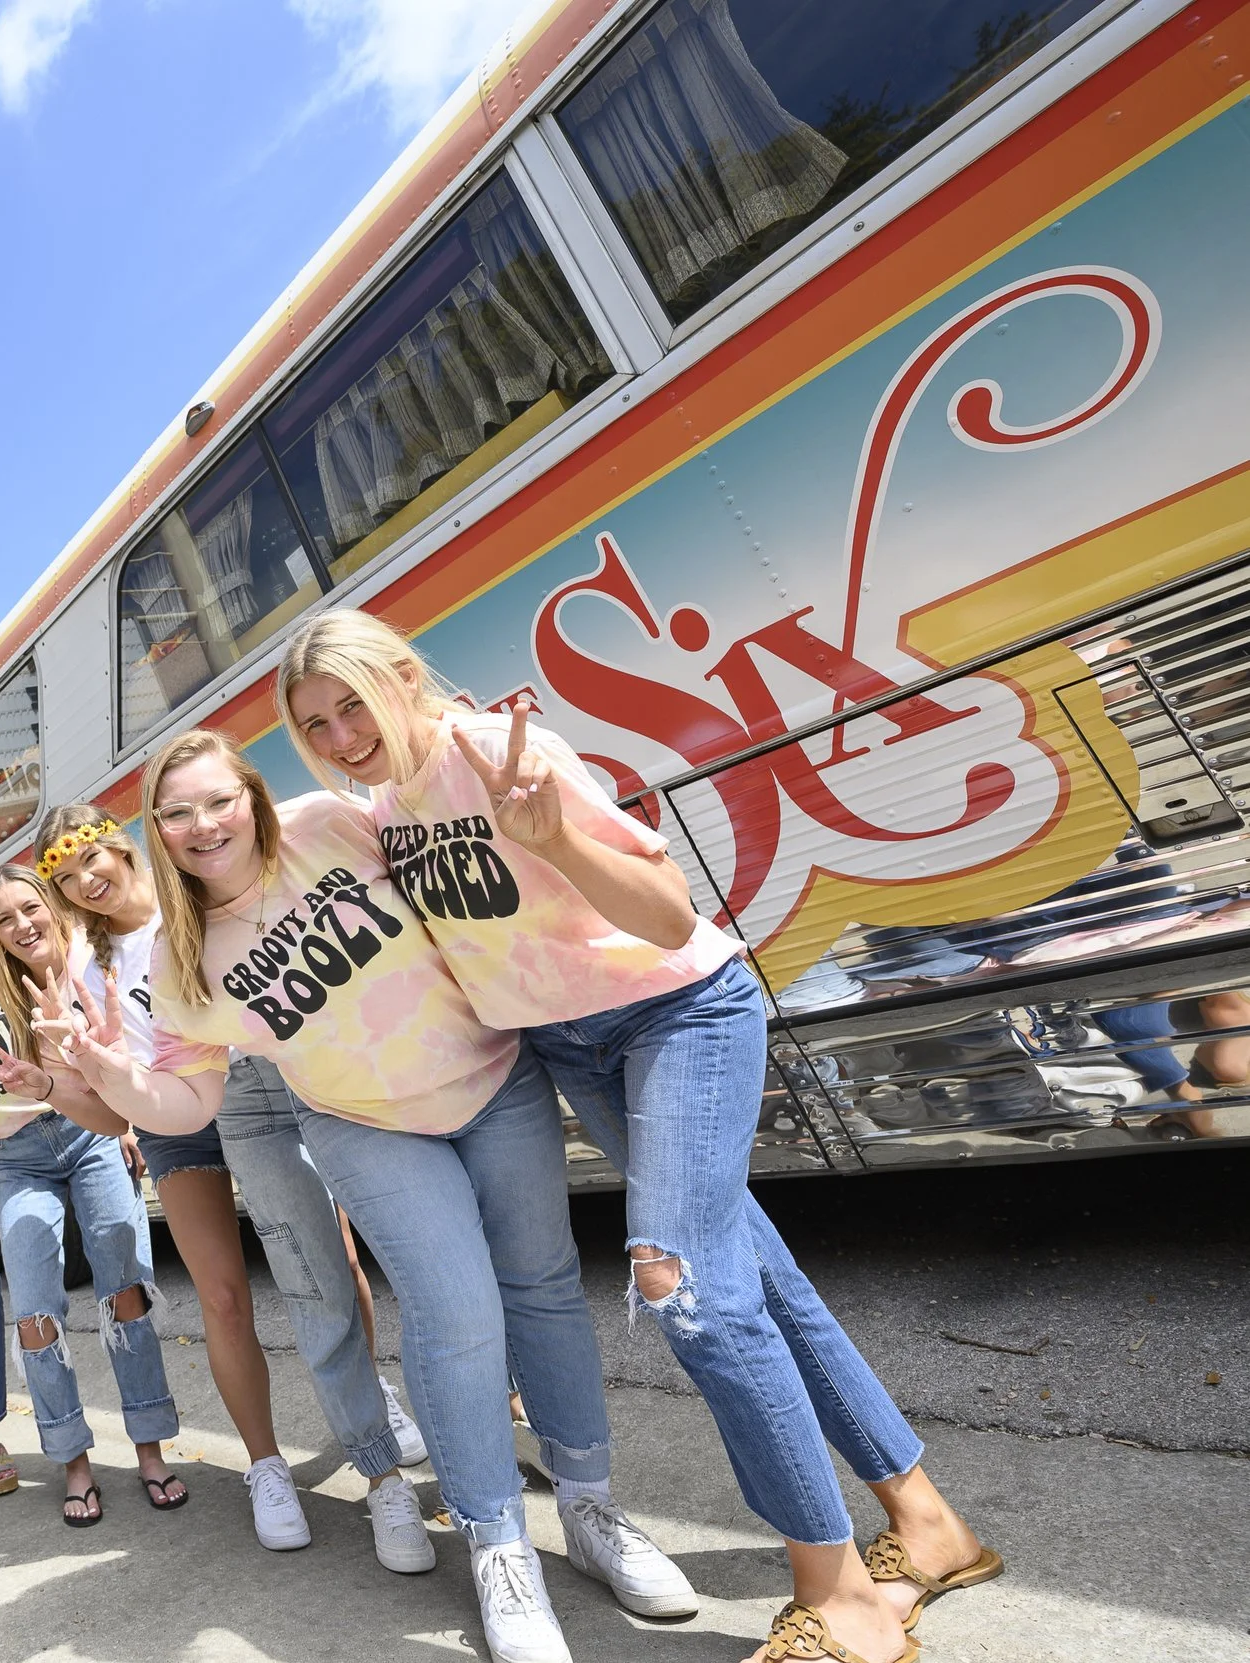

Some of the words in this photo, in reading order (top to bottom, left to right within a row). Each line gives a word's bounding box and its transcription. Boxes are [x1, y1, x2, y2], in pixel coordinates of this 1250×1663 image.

[380, 824, 428, 864] OZED
[433, 815, 494, 844] AND
[391, 839, 521, 923] FUSED
[222, 906, 309, 1002] GROOVY
[302, 867, 358, 914] AND
[247, 883, 404, 1042] BOOZY
